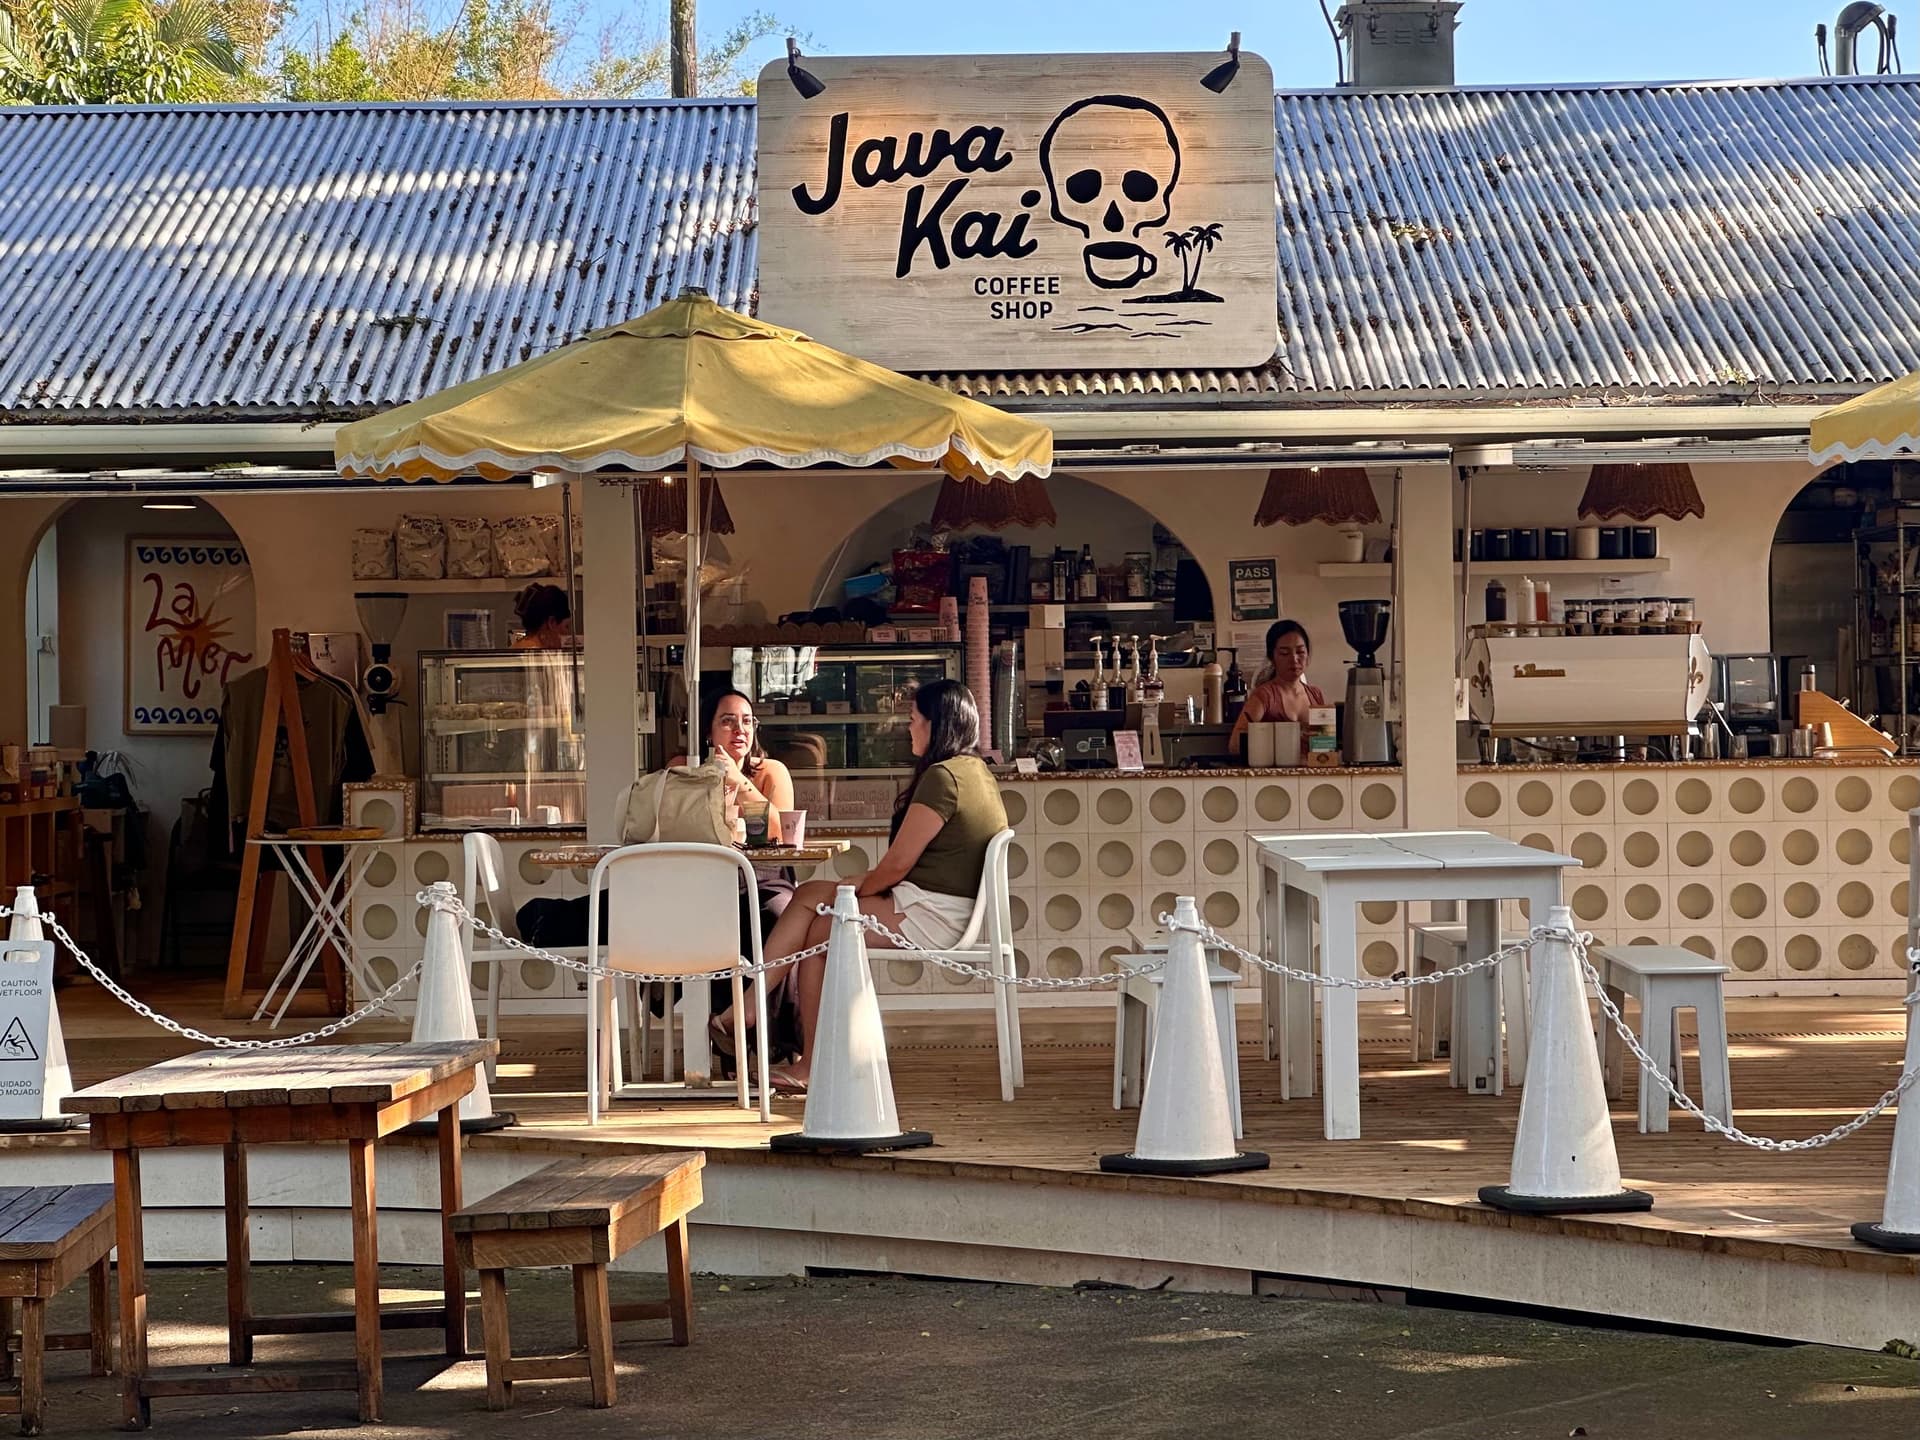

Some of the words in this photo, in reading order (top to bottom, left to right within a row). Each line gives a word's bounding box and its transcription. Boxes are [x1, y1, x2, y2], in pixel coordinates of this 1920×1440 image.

[791, 111, 1013, 216] Java
[896, 178, 1042, 279] Kai
[974, 277, 1061, 296] COFFEE
[990, 301, 1054, 321] SHOP
[1235, 567, 1270, 578] PASS
[143, 573, 203, 632] La
[157, 636, 252, 699] Mer
[1, 979, 38, 987] CAUTION
[0, 1080, 32, 1088] UIDADO
